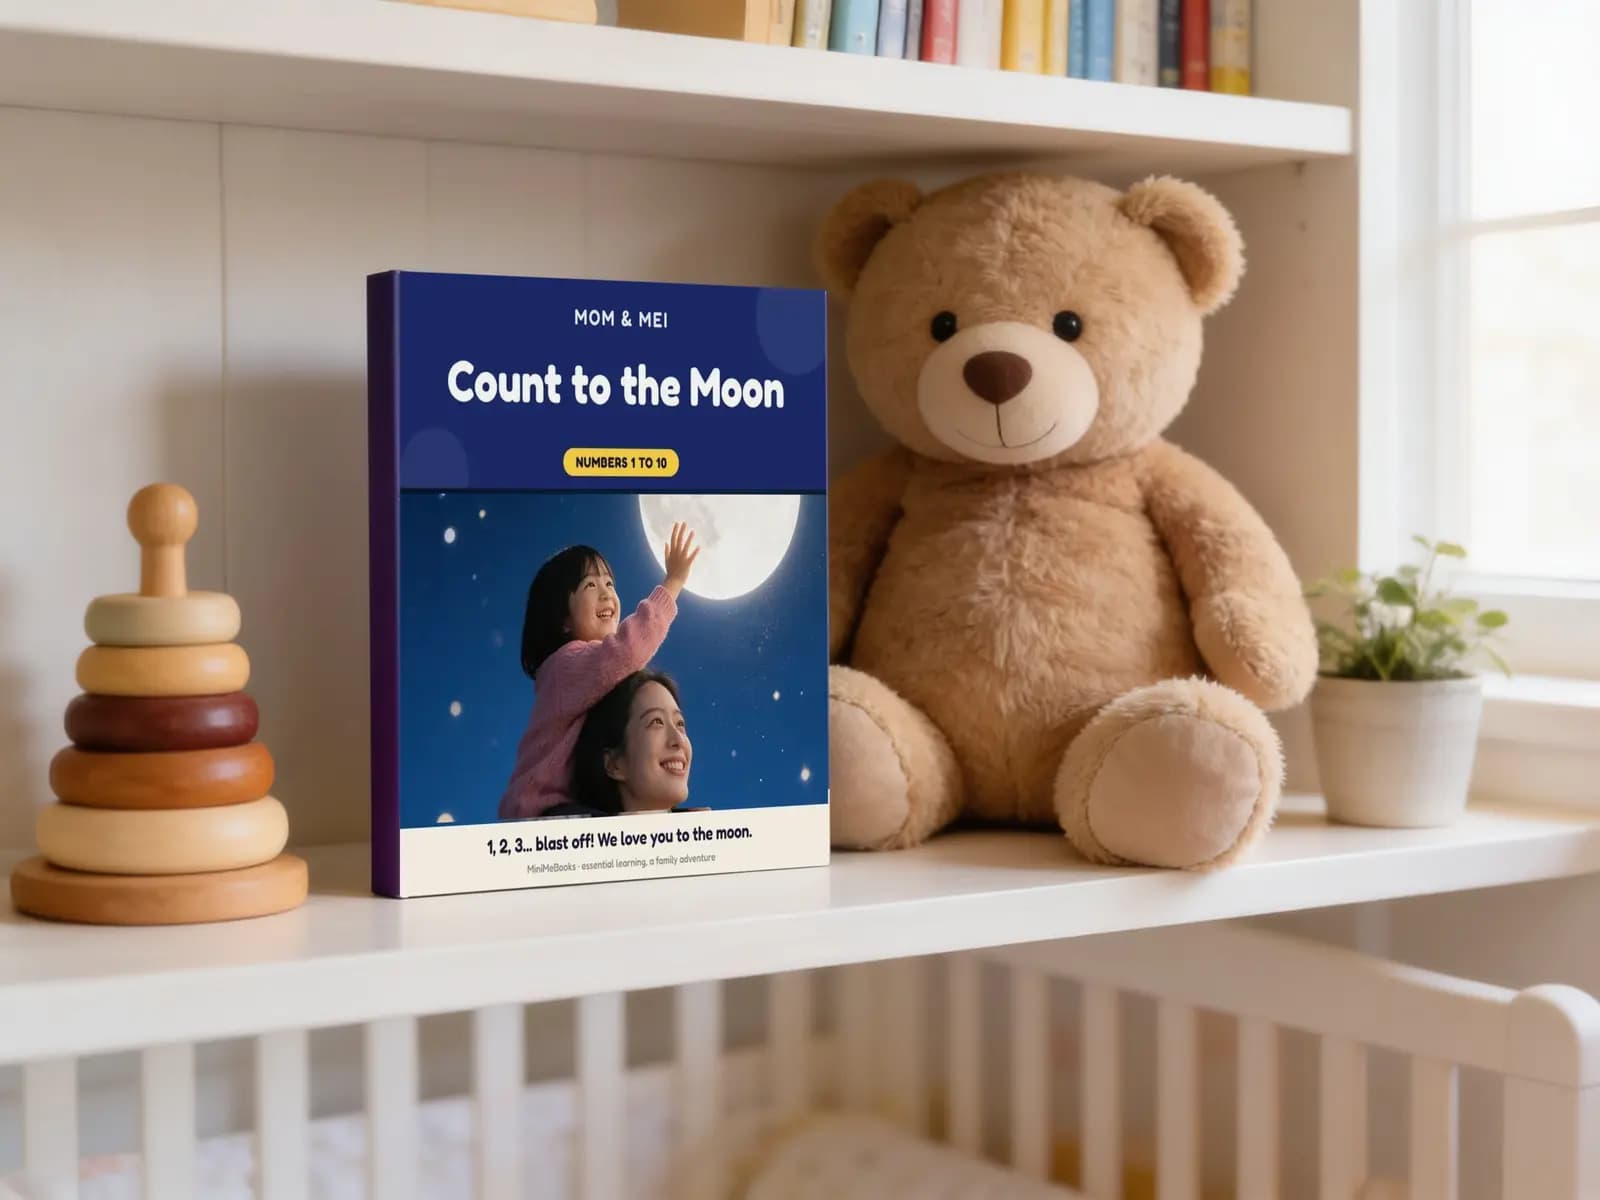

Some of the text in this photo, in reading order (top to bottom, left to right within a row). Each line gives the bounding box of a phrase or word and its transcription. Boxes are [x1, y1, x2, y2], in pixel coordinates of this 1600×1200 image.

[574, 308, 668, 329] MOM & MEI
[447, 360, 785, 409] Count to the Moon
[575, 456, 668, 469] NUMBERS 1 TO 10
[487, 839, 497, 857] 1,
[499, 838, 512, 856] 2,
[535, 835, 569, 852] blast
[571, 832, 595, 850] off!
[597, 831, 618, 848] We
[620, 830, 648, 847] love
[649, 831, 674, 849] you
[675, 828, 690, 843] to
[692, 825, 714, 842] the
[715, 827, 753, 841] moon.
[526, 862, 577, 874] MiniMeBooks
[581, 859, 615, 871] essential
[615, 857, 648, 869] learning,
[655, 856, 679, 866] family
[679, 854, 716, 865] adventure
